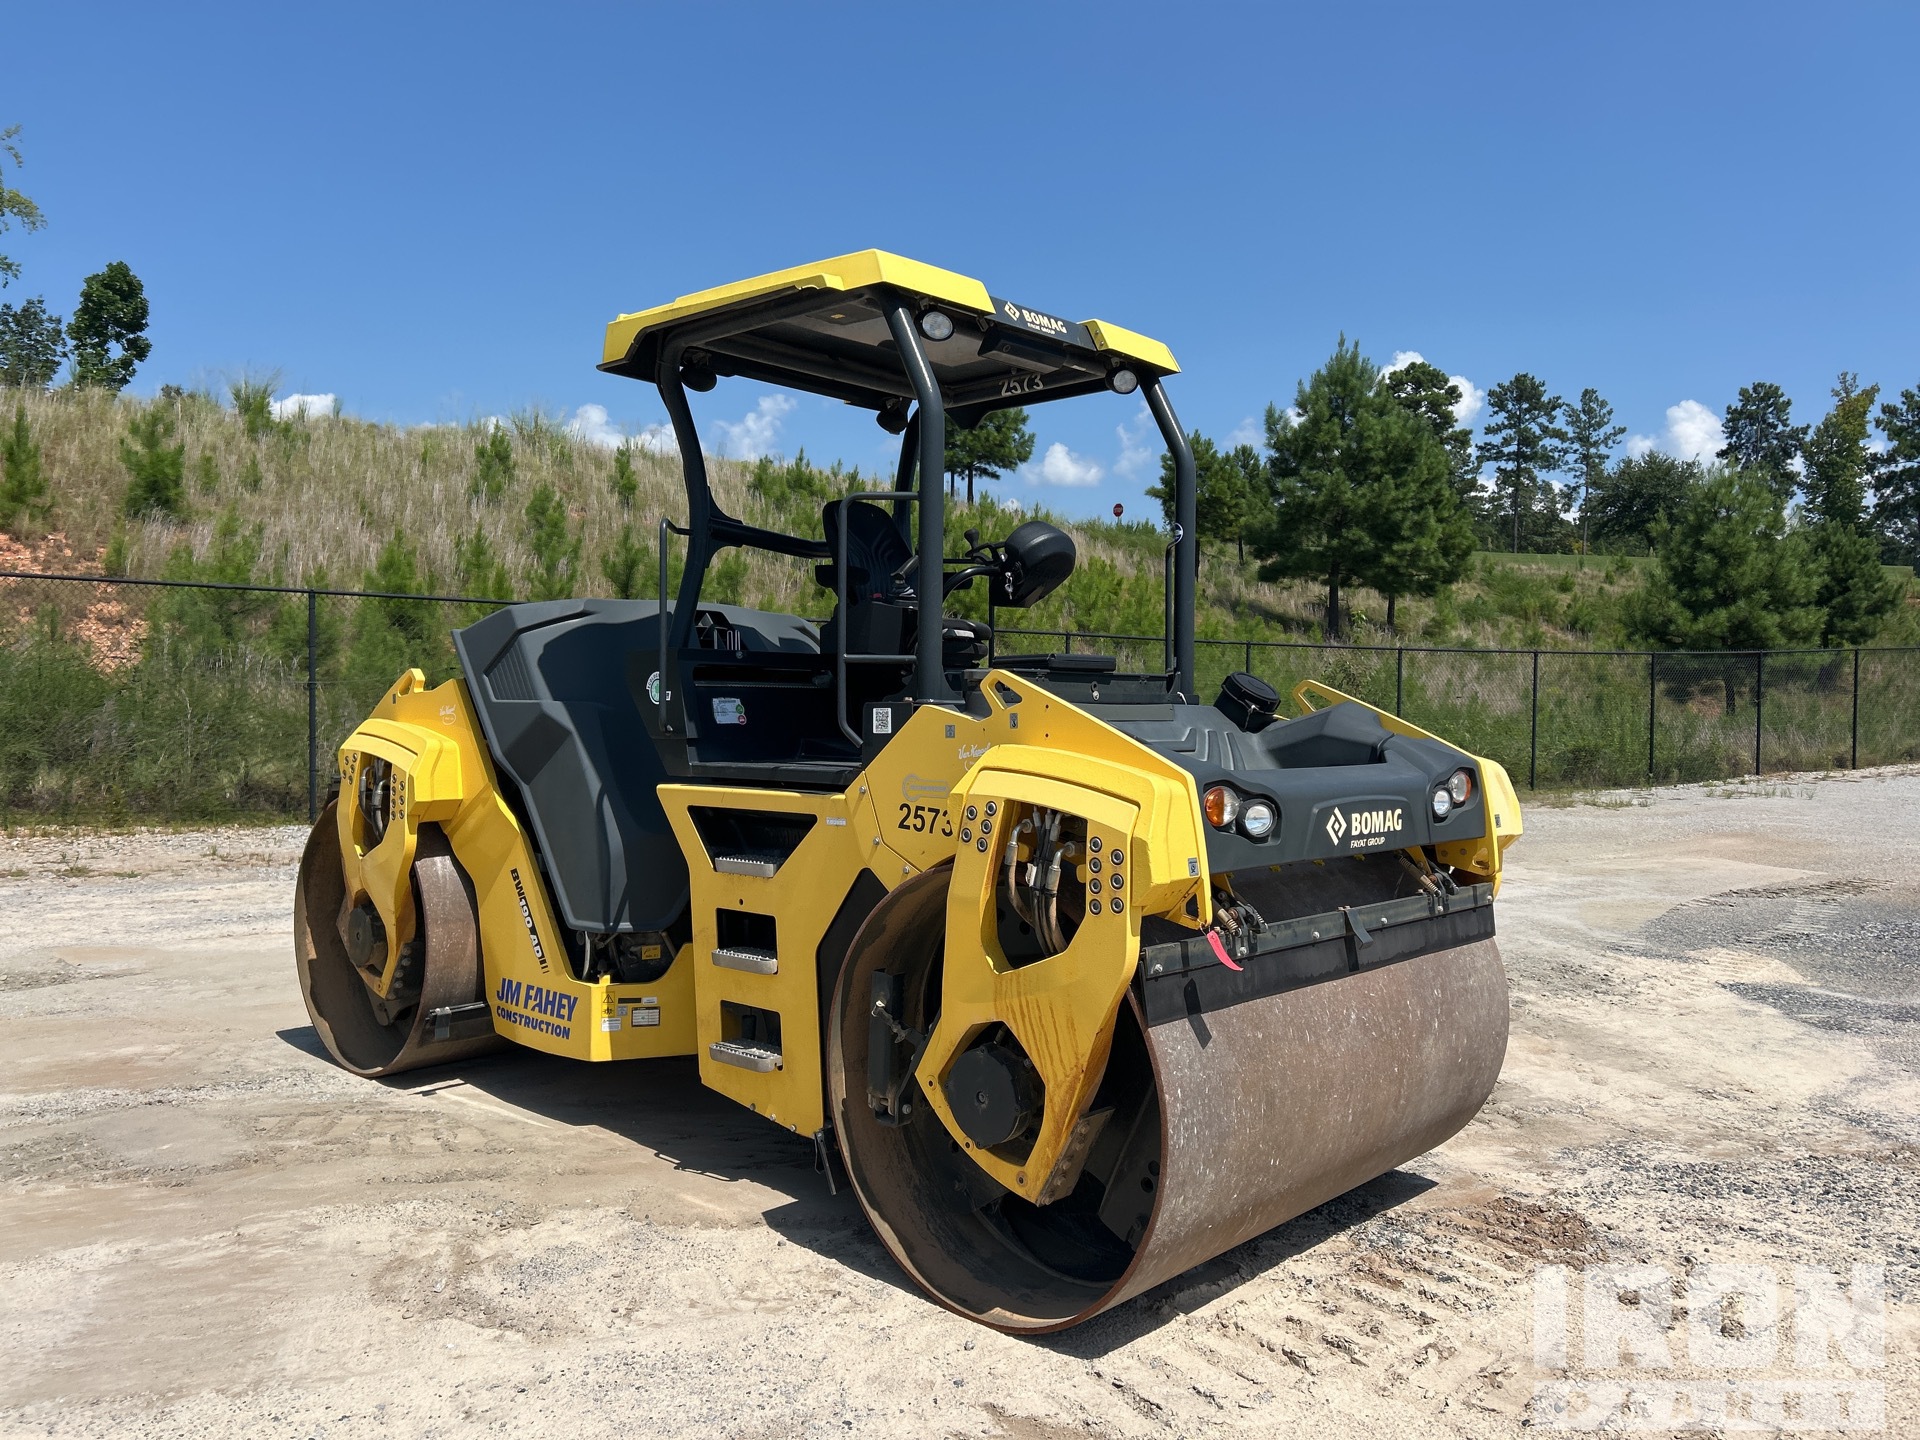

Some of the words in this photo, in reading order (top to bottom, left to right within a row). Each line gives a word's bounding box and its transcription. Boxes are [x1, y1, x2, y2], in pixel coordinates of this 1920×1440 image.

[1022, 309, 1067, 334] BOMAG
[998, 373, 1044, 397] 2573
[897, 803, 954, 837] 2573
[1351, 808, 1403, 836] BOMAG
[1350, 838, 1367, 849] FAYAT
[1367, 836, 1386, 846] GROUP
[496, 977, 522, 1007] JM
[523, 983, 579, 1022] FAHEY
[496, 1005, 571, 1040] CONSTRUCTION
